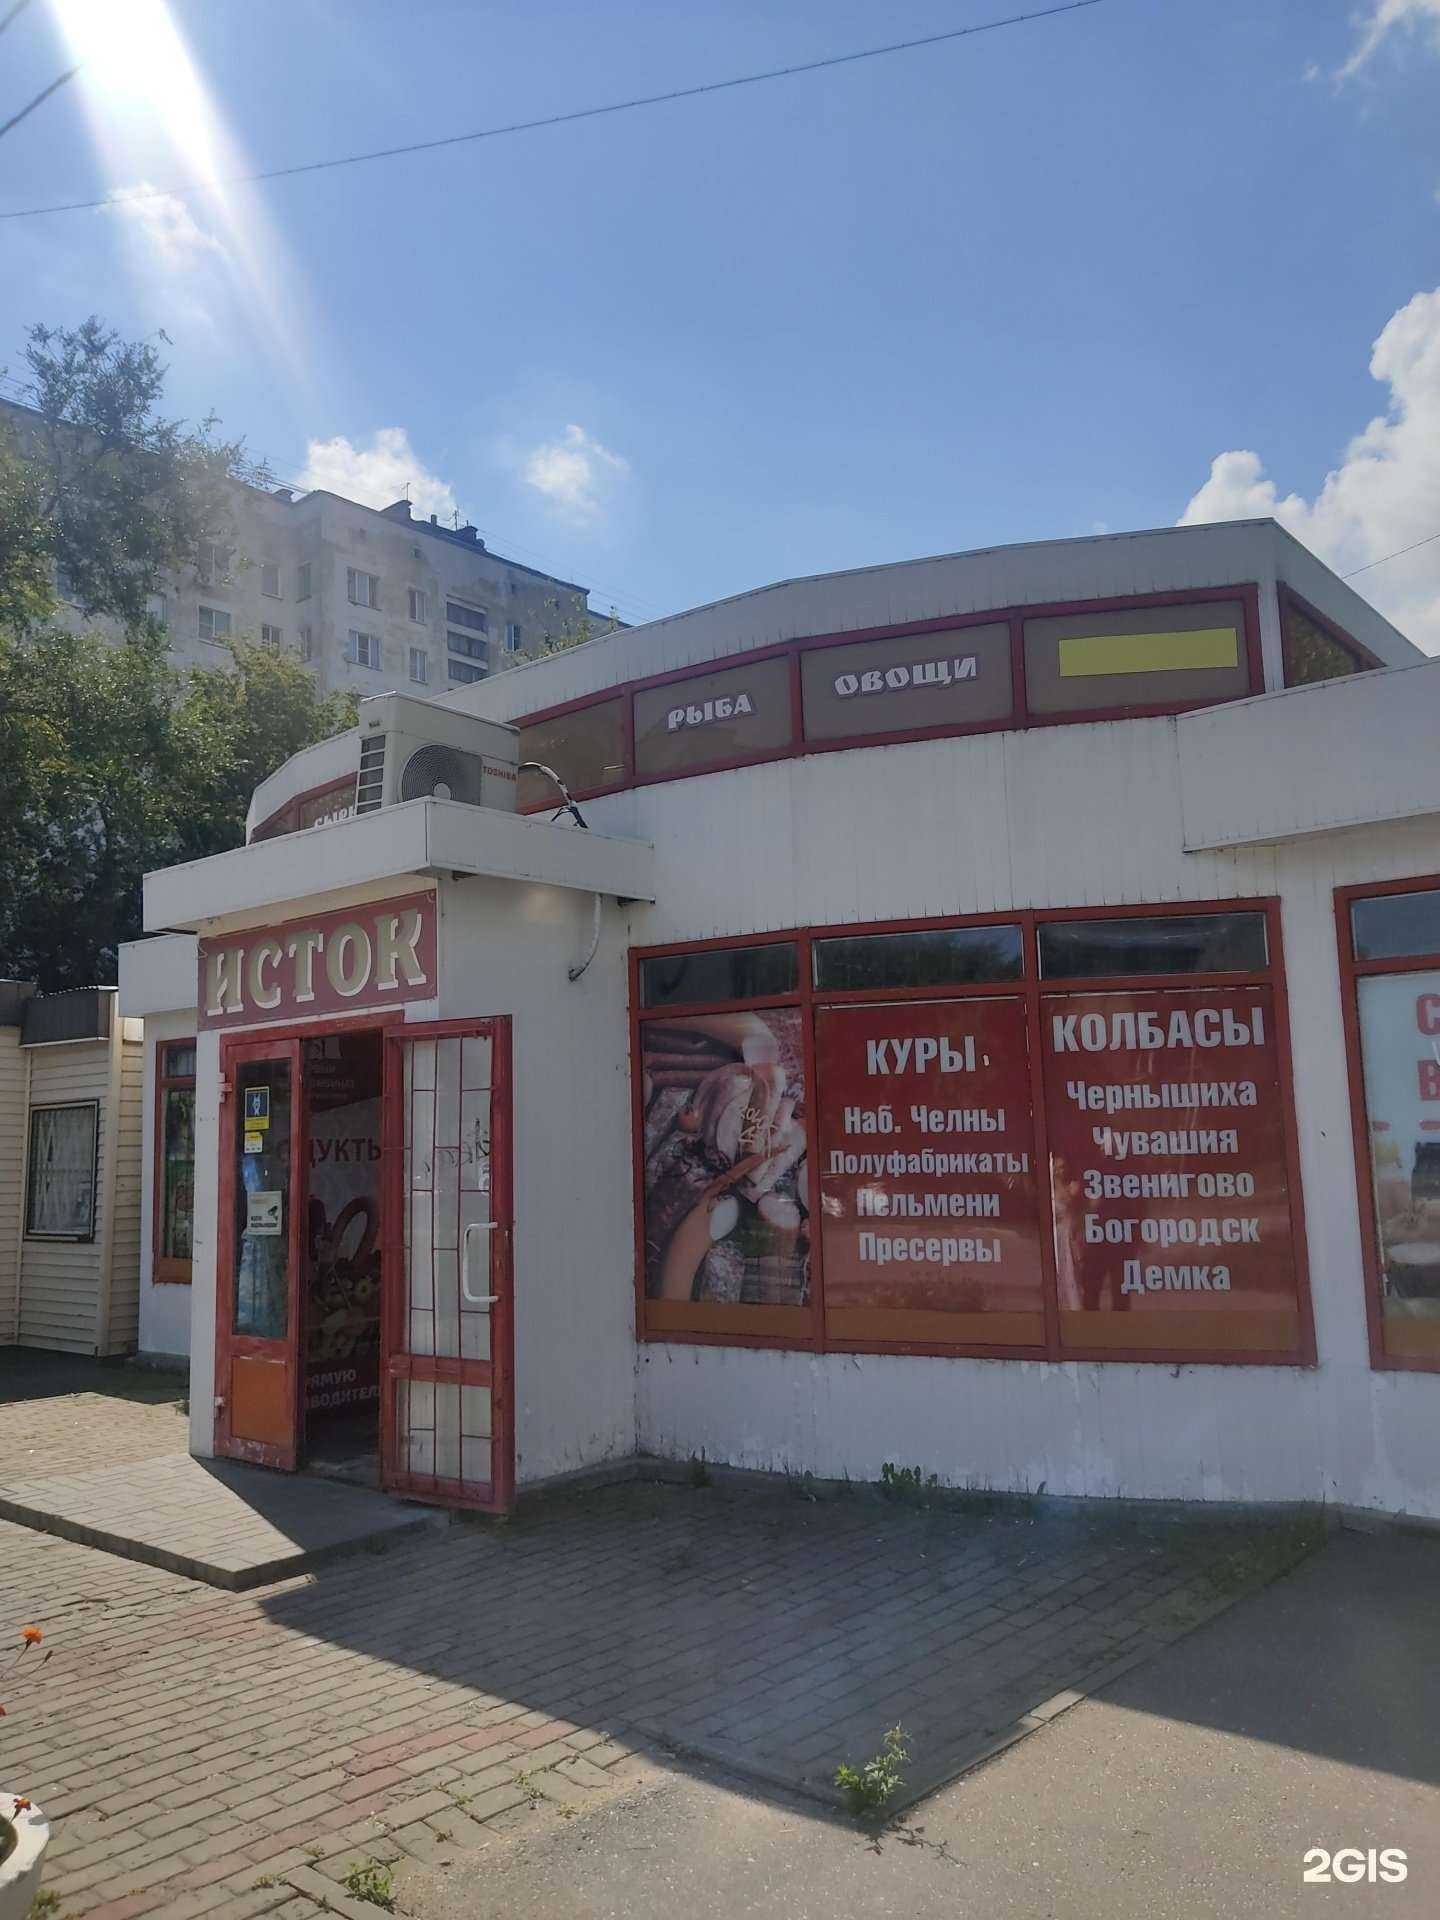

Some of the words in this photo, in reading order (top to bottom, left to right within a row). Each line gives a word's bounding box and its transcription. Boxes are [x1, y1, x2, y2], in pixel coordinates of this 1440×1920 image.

[833, 655, 979, 697] ОВОЩИ
[666, 693, 752, 731] РЫБА
[483, 766, 518, 782] TOSHIBA
[205, 908, 427, 1017] ИСТОК
[1052, 1007, 1265, 1053] КОЛБАСЫ
[866, 1035, 976, 1076] КУРЫ
[1066, 1080, 1258, 1114] Чернышиха
[844, 1104, 901, 1135] Наб.
[910, 1104, 1006, 1133] Челны
[1092, 1126, 1239, 1160] Чувашия
[829, 1148, 1029, 1178] Полуфабрикаты
[1083, 1169, 1256, 1200] Звенигово
[856, 1187, 1001, 1218] Пельмени
[1084, 1213, 1261, 1248] Богородск
[859, 1231, 1002, 1266] Пресервы
[1121, 1259, 1232, 1295] Демка
